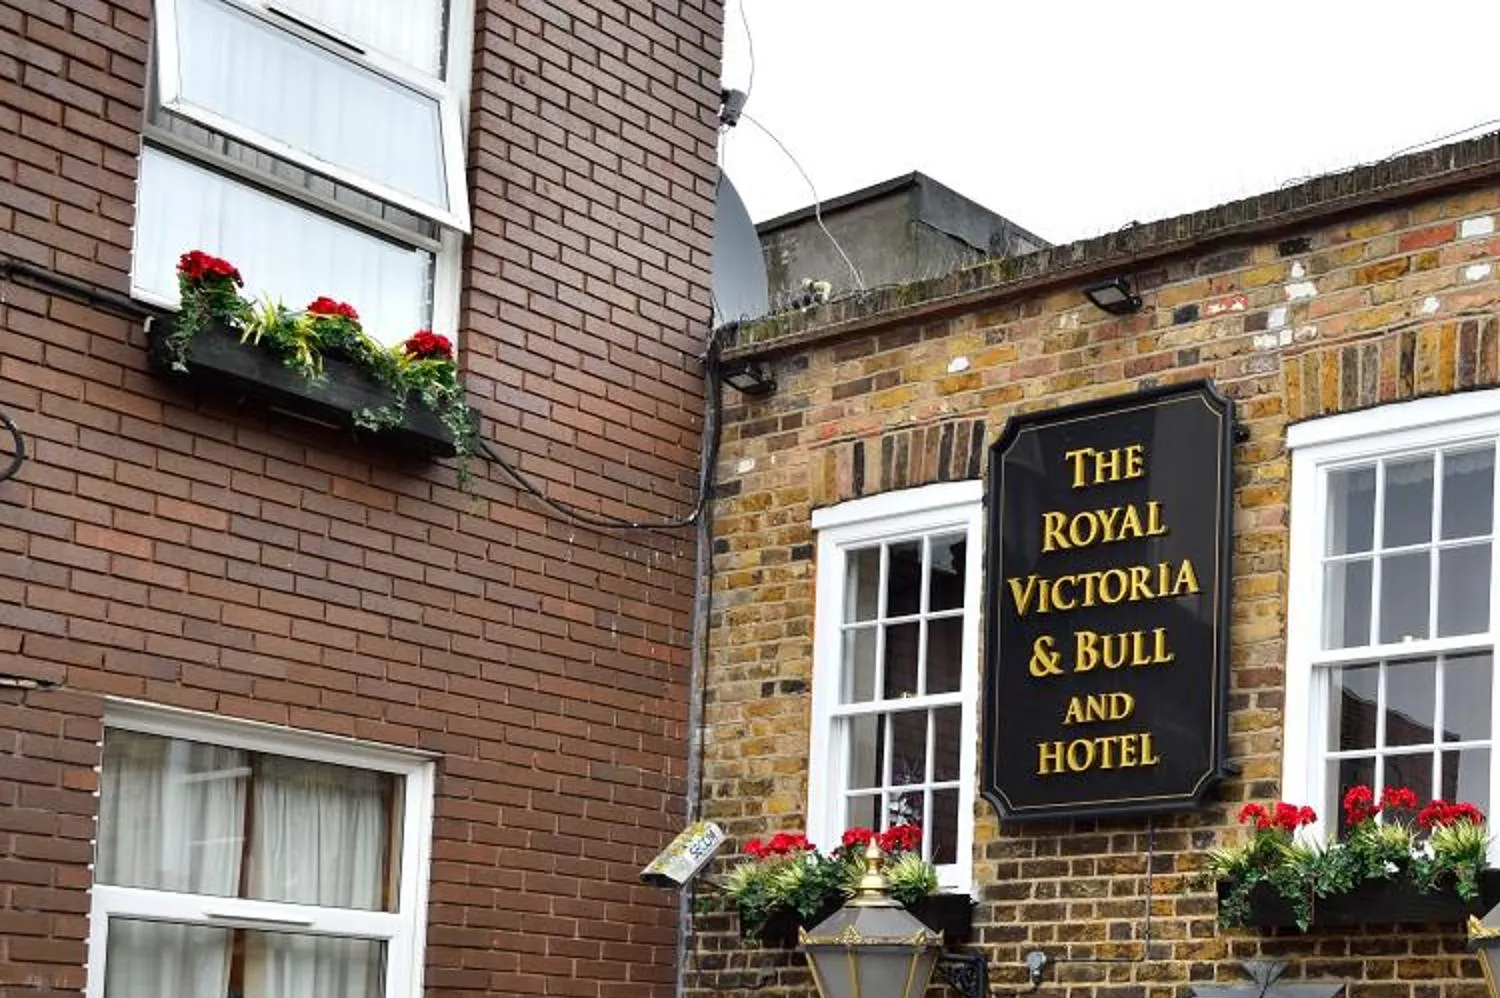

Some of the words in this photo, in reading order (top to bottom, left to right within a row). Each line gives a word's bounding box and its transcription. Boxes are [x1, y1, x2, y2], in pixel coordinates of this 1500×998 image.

[1065, 444, 1144, 488] THE
[1041, 501, 1168, 553] ROYAL
[1008, 558, 1200, 617] VICTORIA
[1028, 634, 1064, 678] &
[1073, 627, 1174, 674] BULL
[1064, 692, 1134, 725] AND
[1035, 733, 1159, 776] HOTEL
